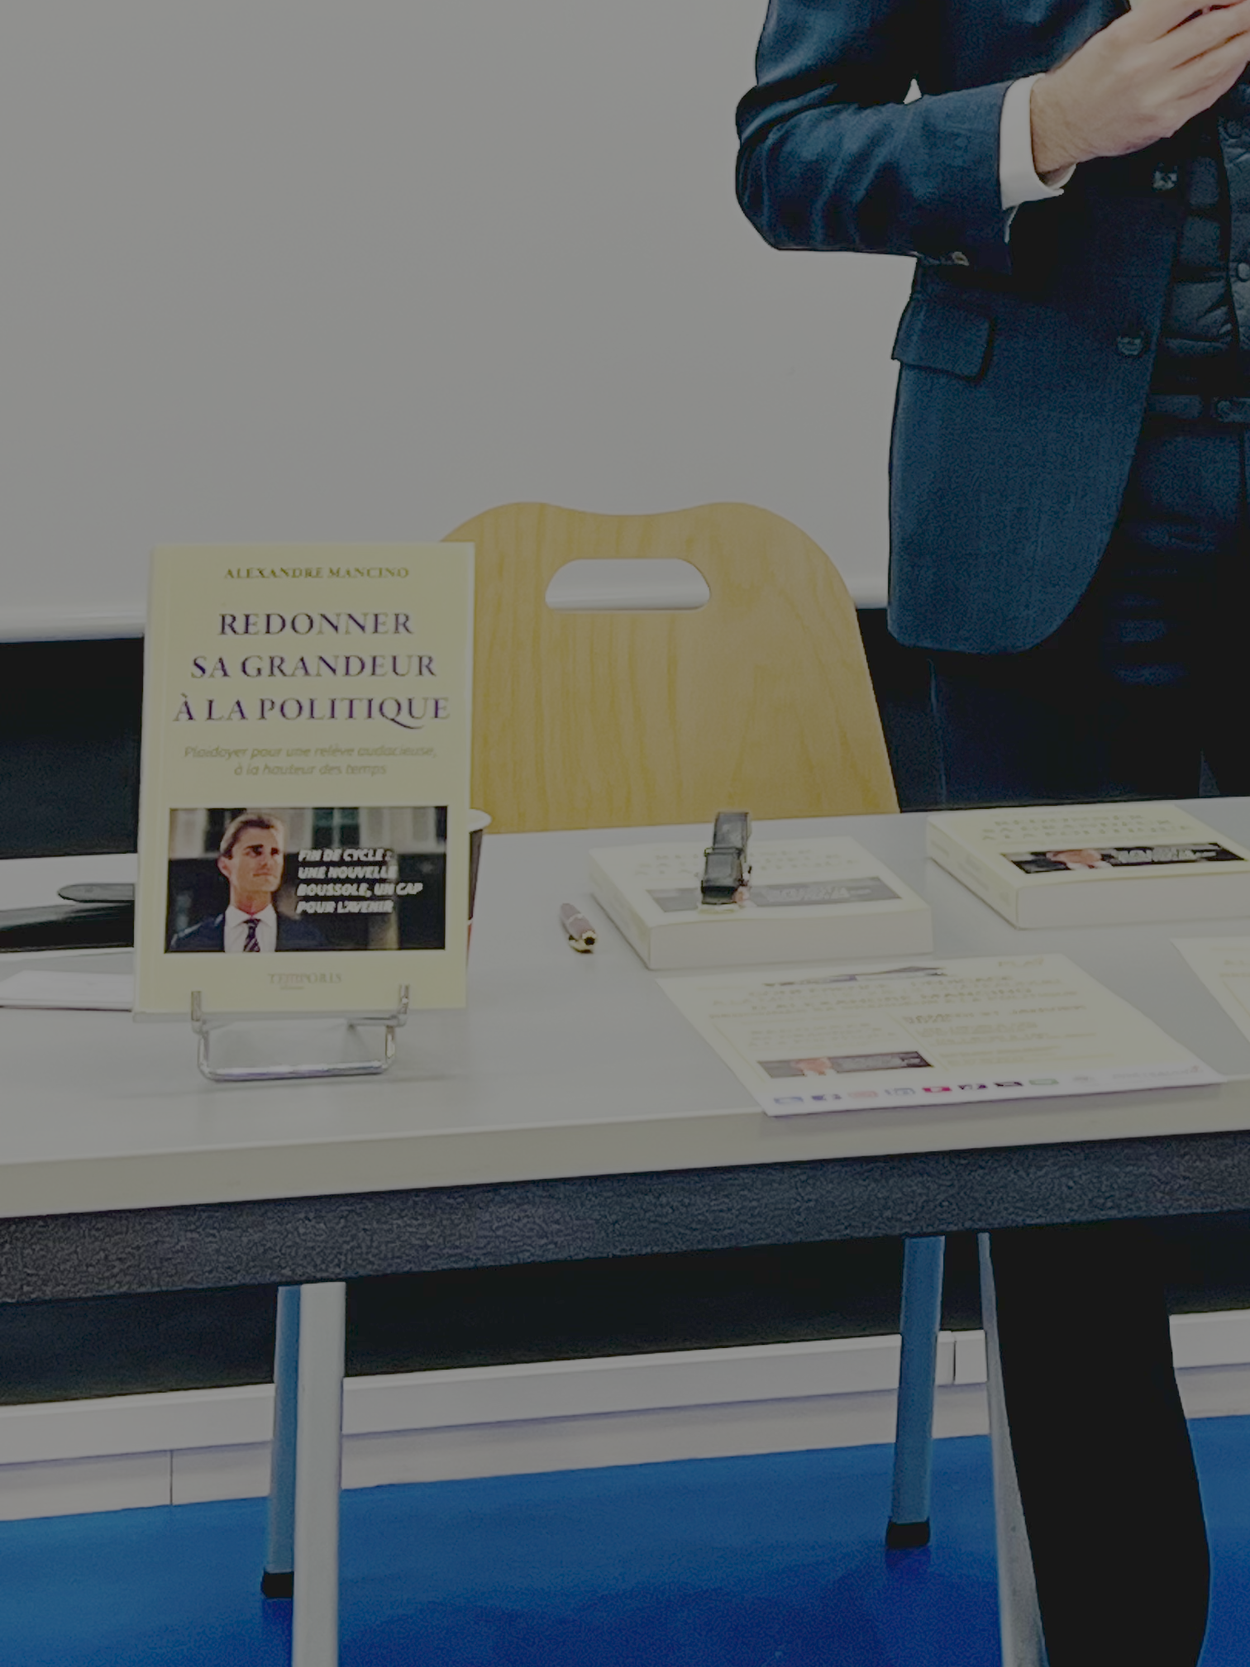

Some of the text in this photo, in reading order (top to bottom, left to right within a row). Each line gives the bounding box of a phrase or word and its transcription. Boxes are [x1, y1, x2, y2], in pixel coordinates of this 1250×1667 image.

[224, 567, 410, 579] ALEXANDRE MANCINO
[218, 612, 415, 636] REDONNER
[190, 654, 437, 679] SA GRANDEUR
[173, 693, 451, 730] À LA POLITIQUE
[185, 745, 248, 760] Plaidoyer
[250, 747, 282, 760] pour
[286, 747, 310, 757] une
[314, 744, 354, 758] relève
[234, 763, 387, 777] à la hauteur des temps
[298, 848, 322, 862] FIN
[323, 848, 342, 861] DE
[343, 848, 384, 862] CYCLE
[298, 865, 398, 879] UNE NOUVELLE
[297, 882, 423, 897] BOUSSOLE, UN CAP
[296, 899, 394, 914] POUR L'AVENIR
